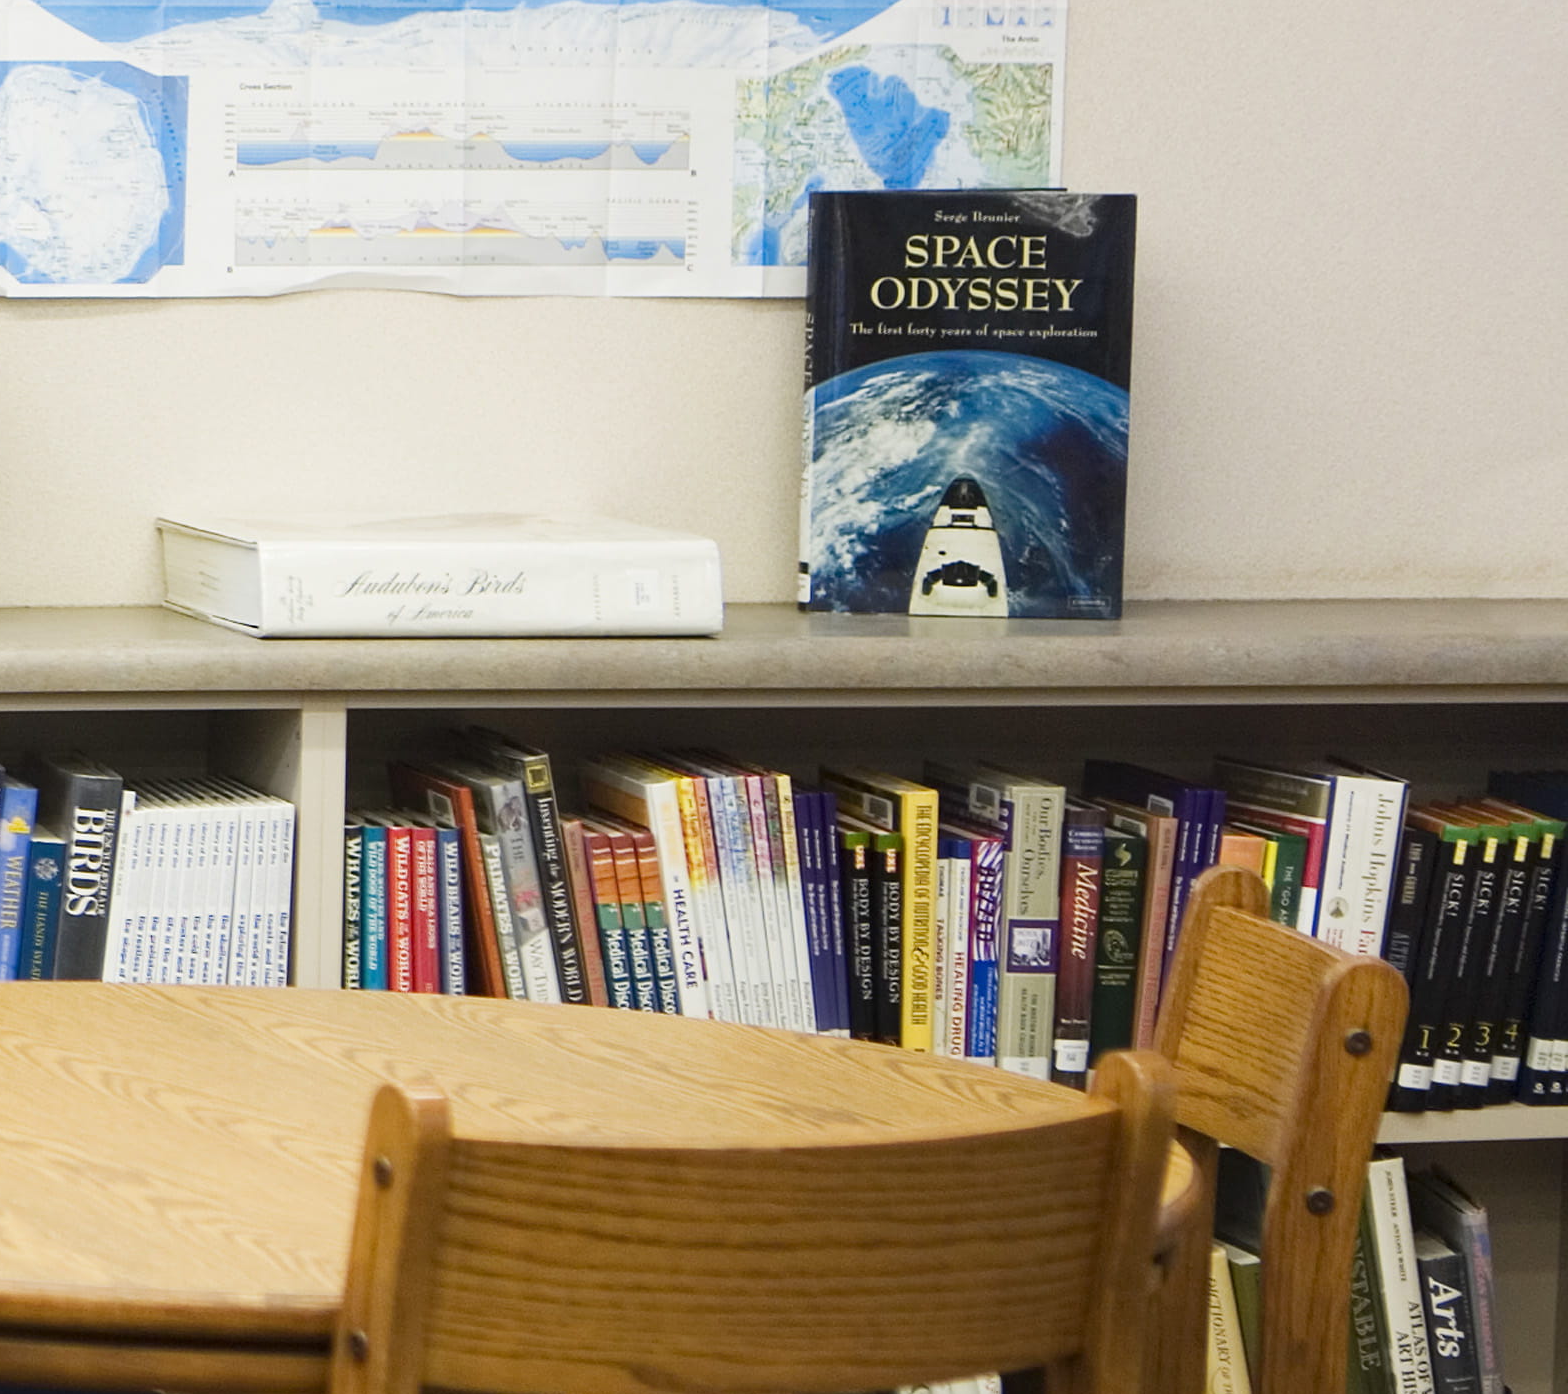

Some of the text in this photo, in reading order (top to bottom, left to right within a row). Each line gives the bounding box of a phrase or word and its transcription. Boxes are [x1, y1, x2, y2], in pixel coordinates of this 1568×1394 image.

[934, 210, 1020, 224] Serge Brunier
[905, 234, 1048, 269] SPACE
[870, 277, 1084, 312] ODYSSEY
[850, 323, 1098, 339] The first forty years of space exploration
[335, 569, 526, 598] Audubon's Birds
[66, 806, 108, 918] BIRDS
[1070, 863, 1099, 960] Medicine
[673, 888, 699, 990] HEALTH CARE
[1428, 1276, 1463, 1359] Arts
